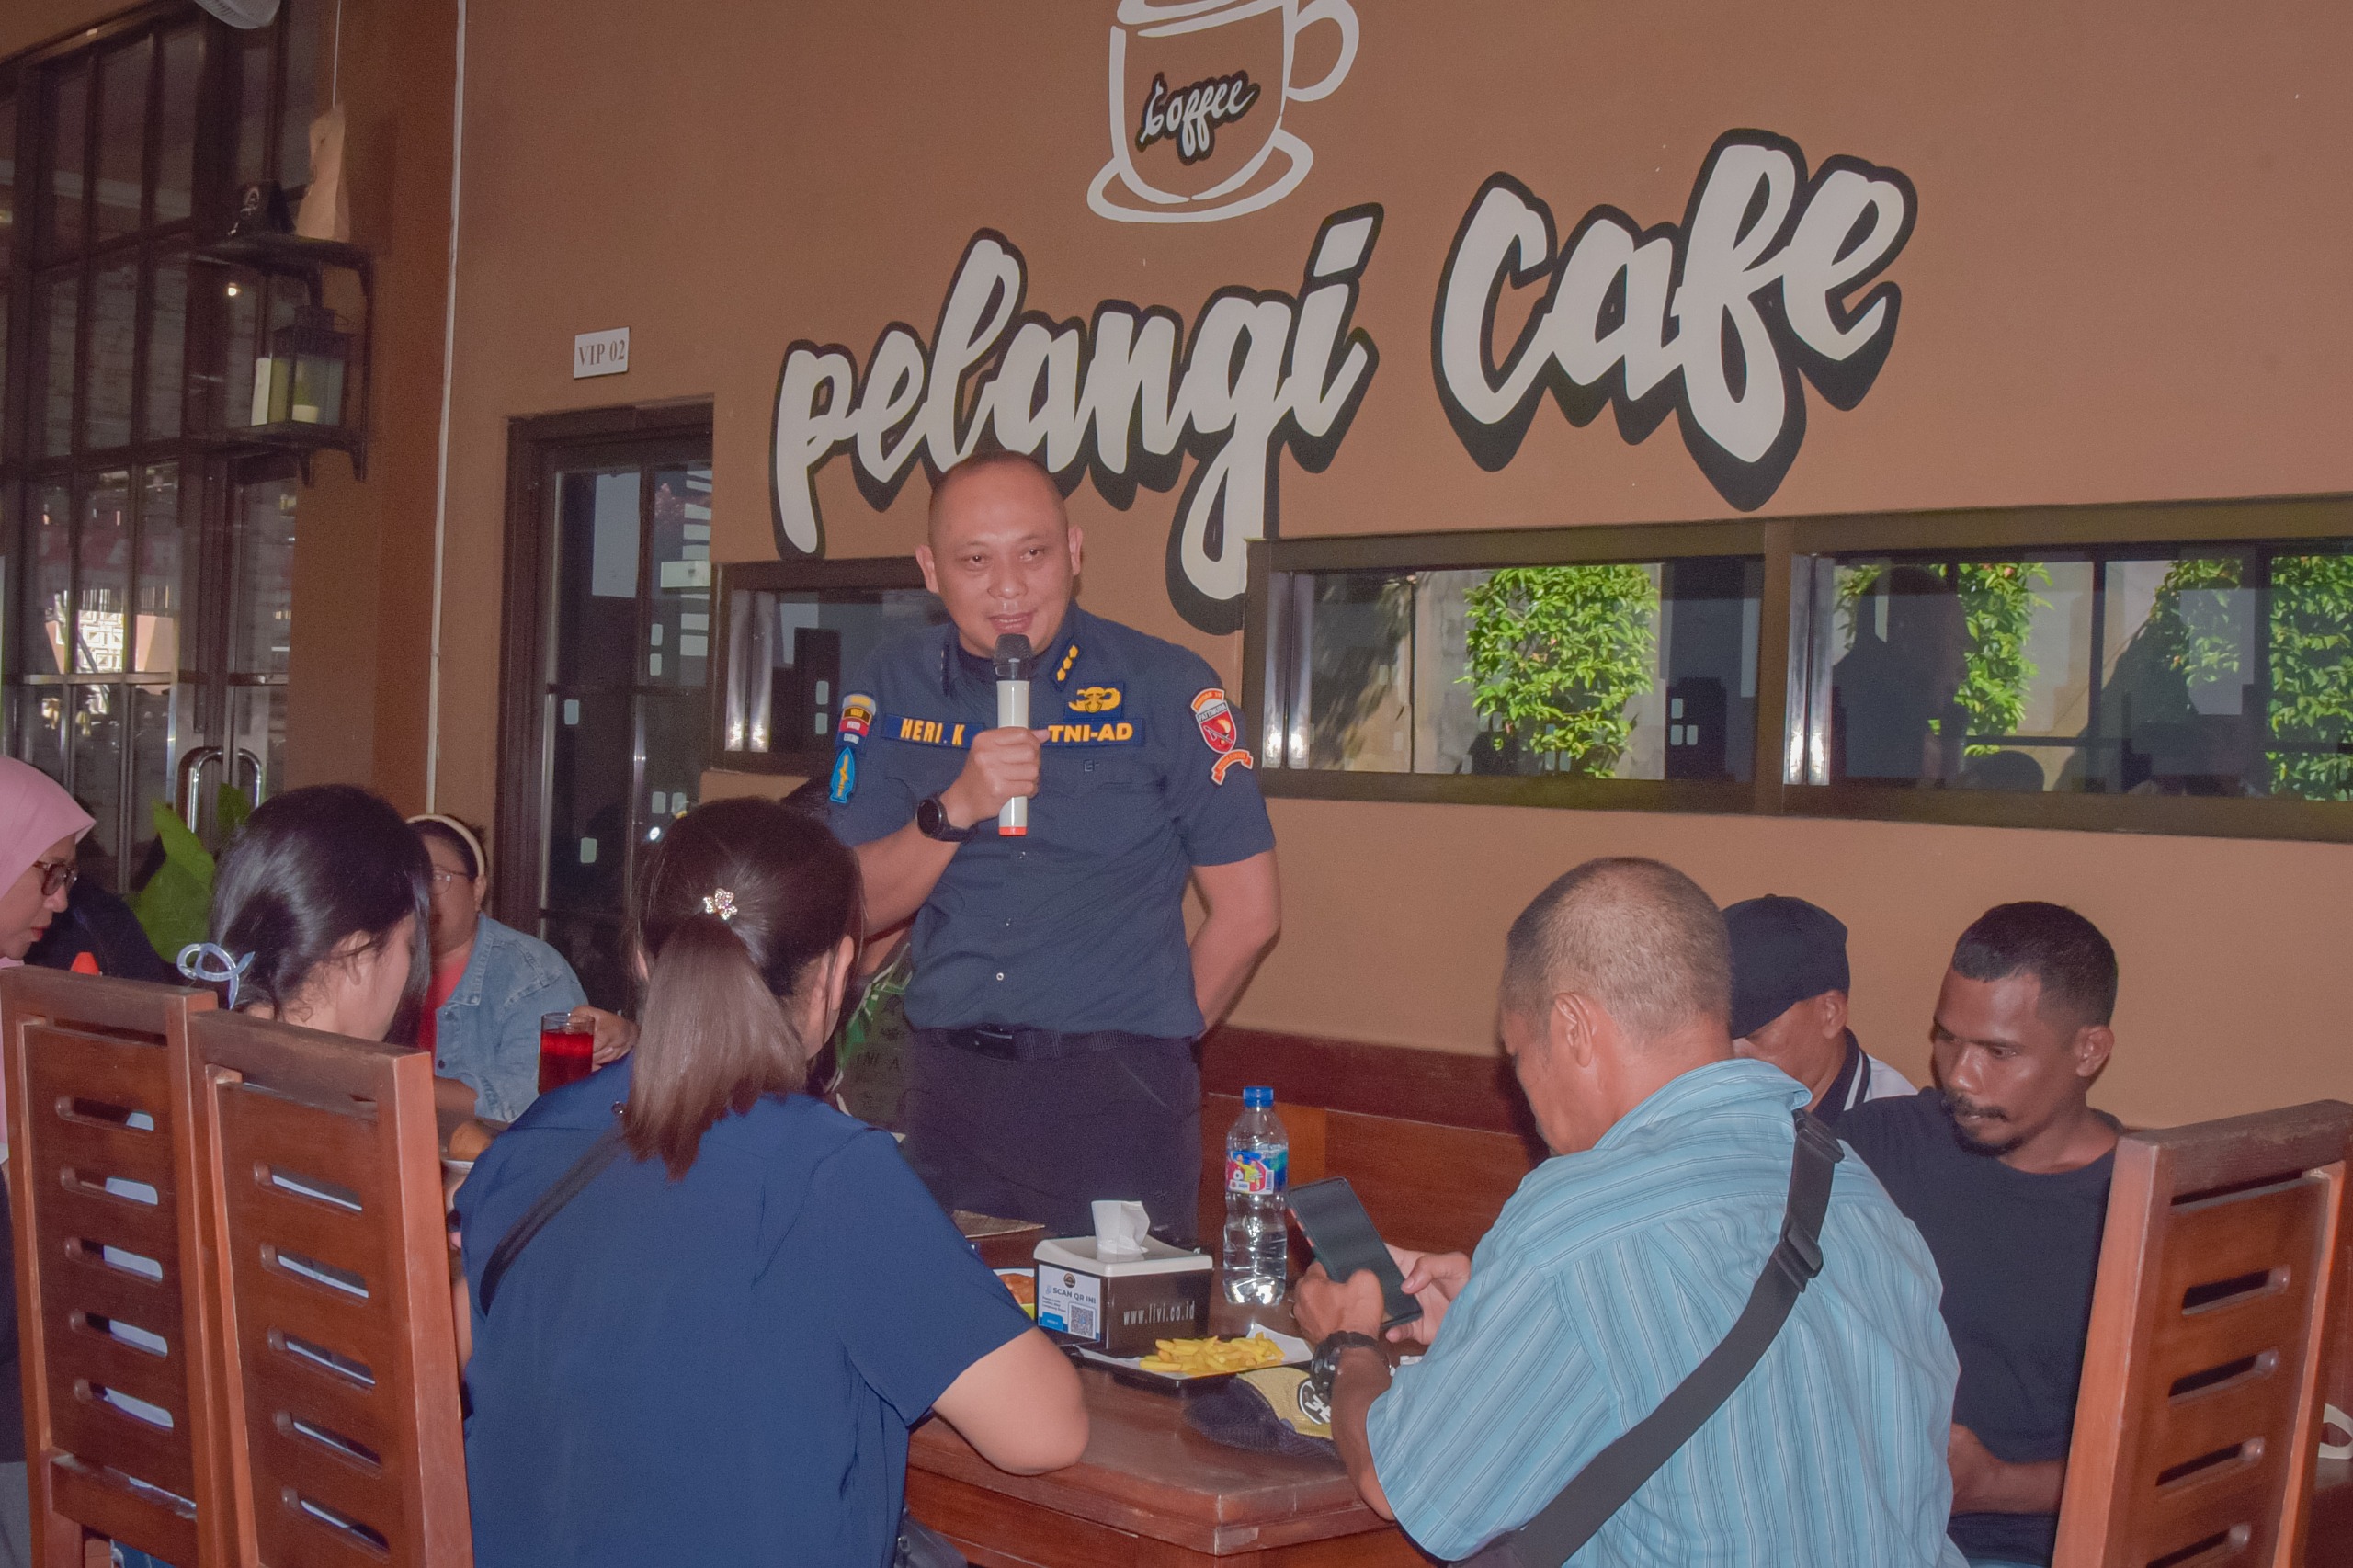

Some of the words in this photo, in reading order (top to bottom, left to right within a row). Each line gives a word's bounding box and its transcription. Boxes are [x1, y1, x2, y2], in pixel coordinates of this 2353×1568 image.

[578, 343, 606, 366] VIP
[609, 339, 625, 362] 02
[1047, 722, 1134, 743] TNI-AD
[1052, 1287, 1073, 1298] SCAN
[1074, 1292, 1085, 1301] QR
